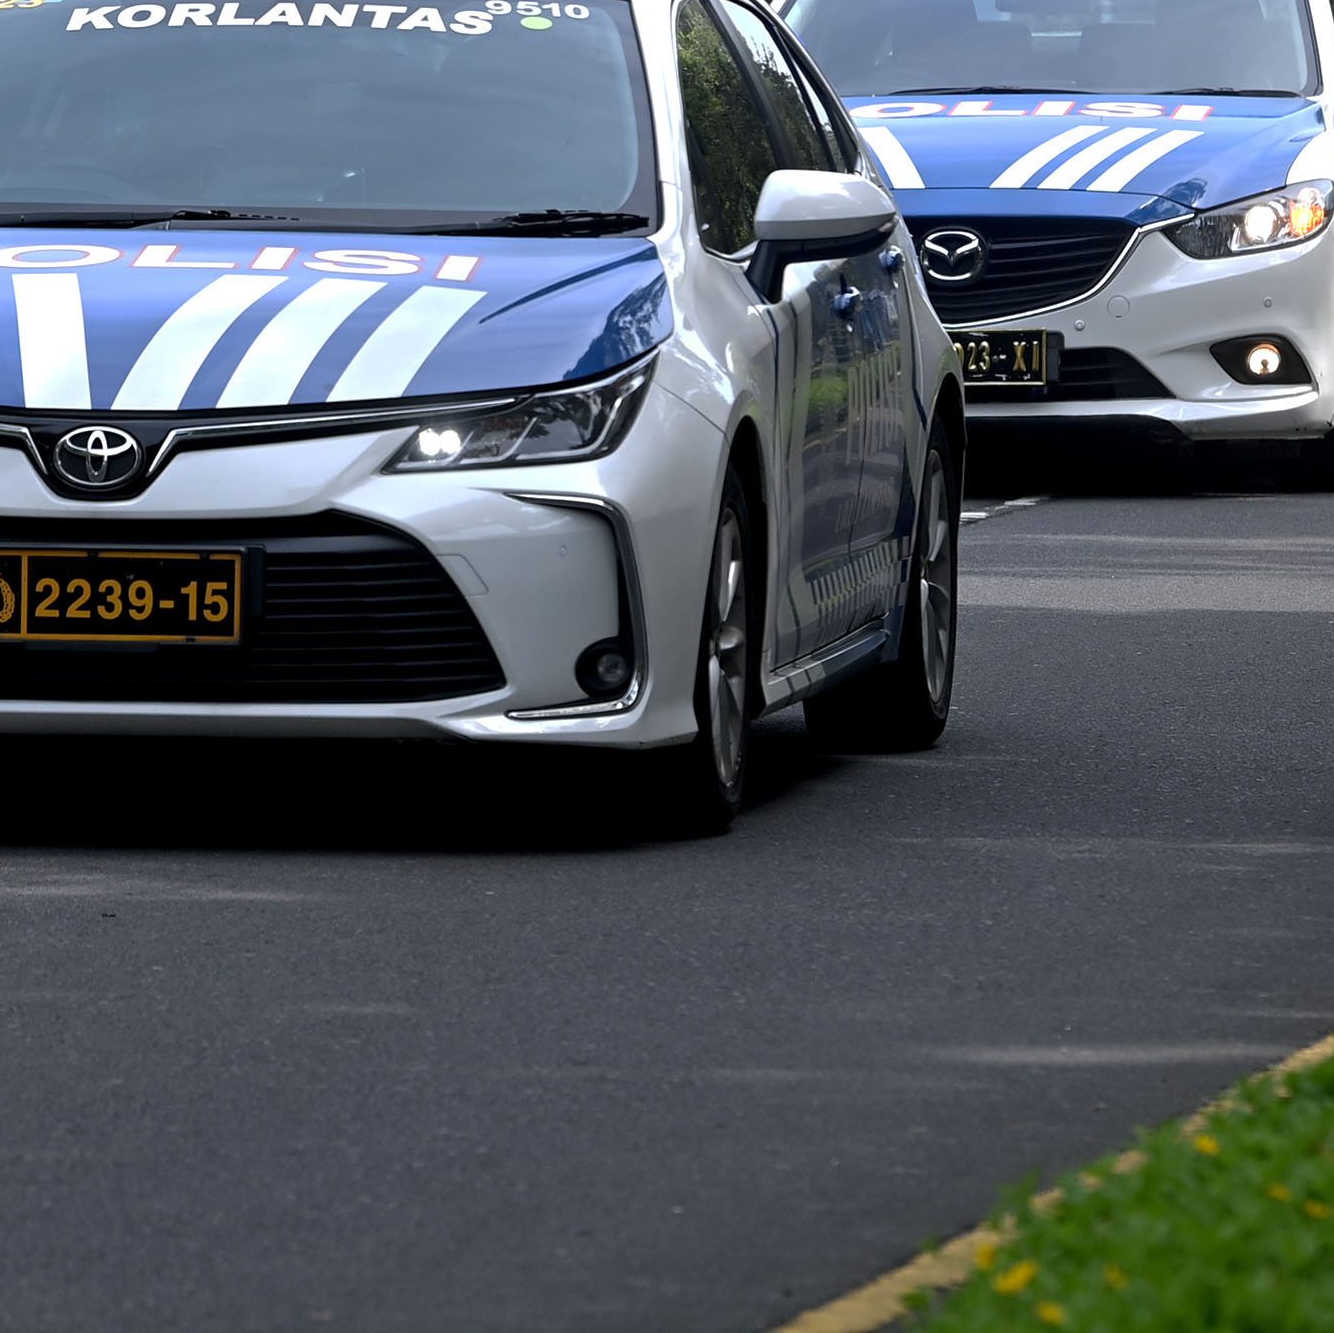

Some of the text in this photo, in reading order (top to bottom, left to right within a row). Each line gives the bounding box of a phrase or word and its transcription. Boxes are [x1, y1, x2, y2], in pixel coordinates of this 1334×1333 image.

[65, 0, 591, 35] KORLANTAS 9510
[848, 100, 1215, 122] OLISI
[34, 577, 229, 623] 2239-15
